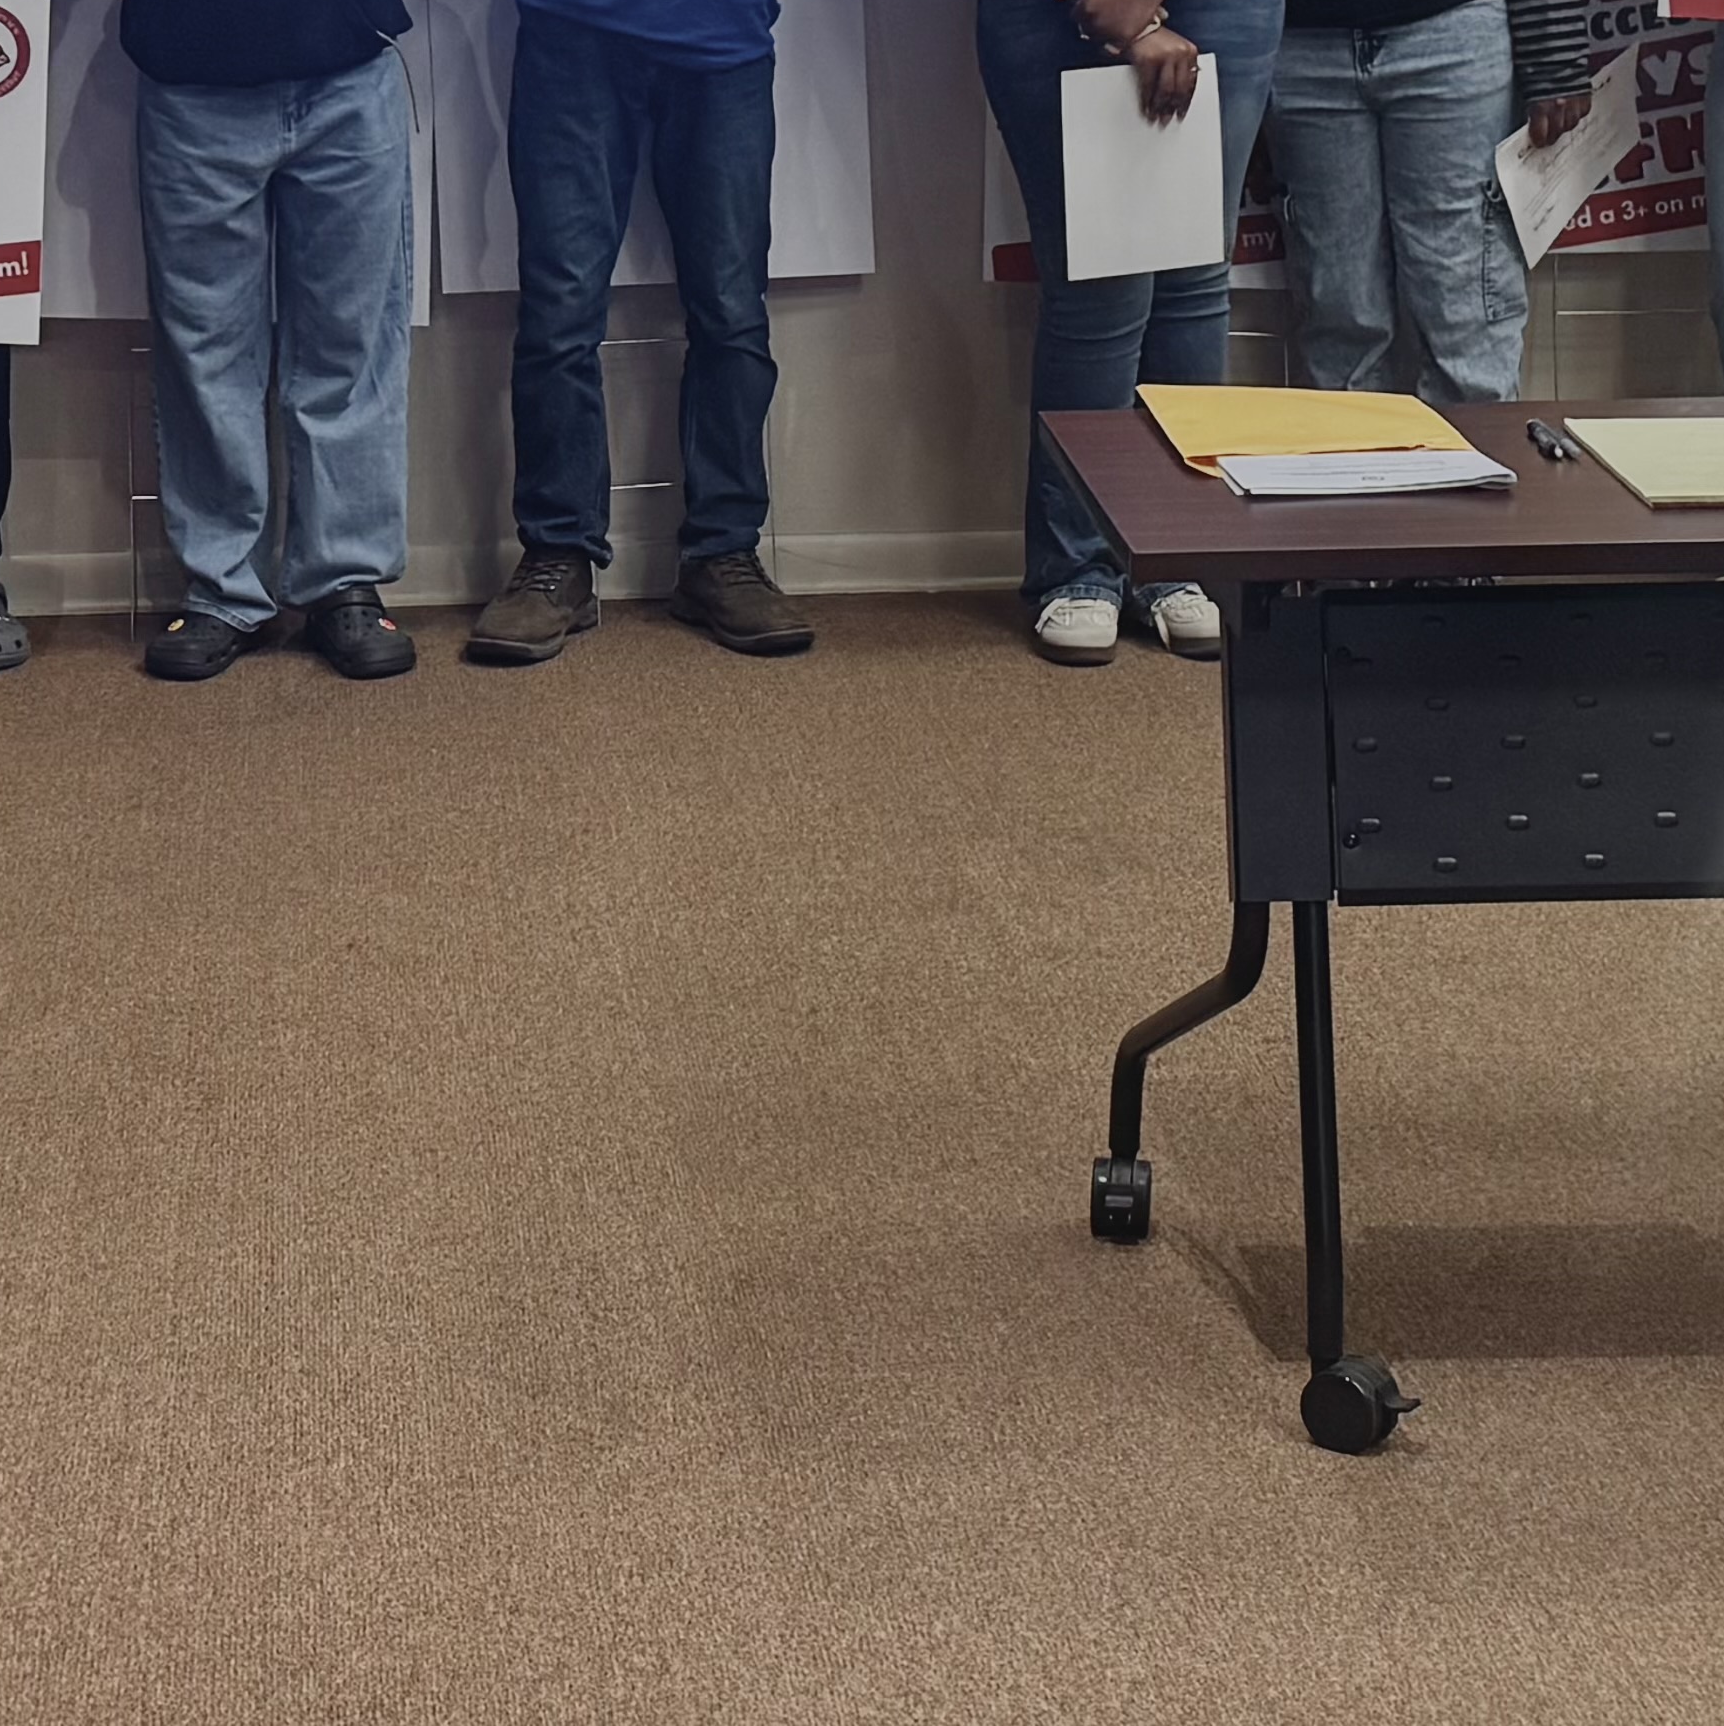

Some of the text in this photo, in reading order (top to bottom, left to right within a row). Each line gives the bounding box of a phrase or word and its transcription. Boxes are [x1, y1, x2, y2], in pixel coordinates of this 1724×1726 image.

[1599, 209, 1616, 224] a
[1621, 200, 1649, 221] 3+
[1655, 197, 1684, 214] on
